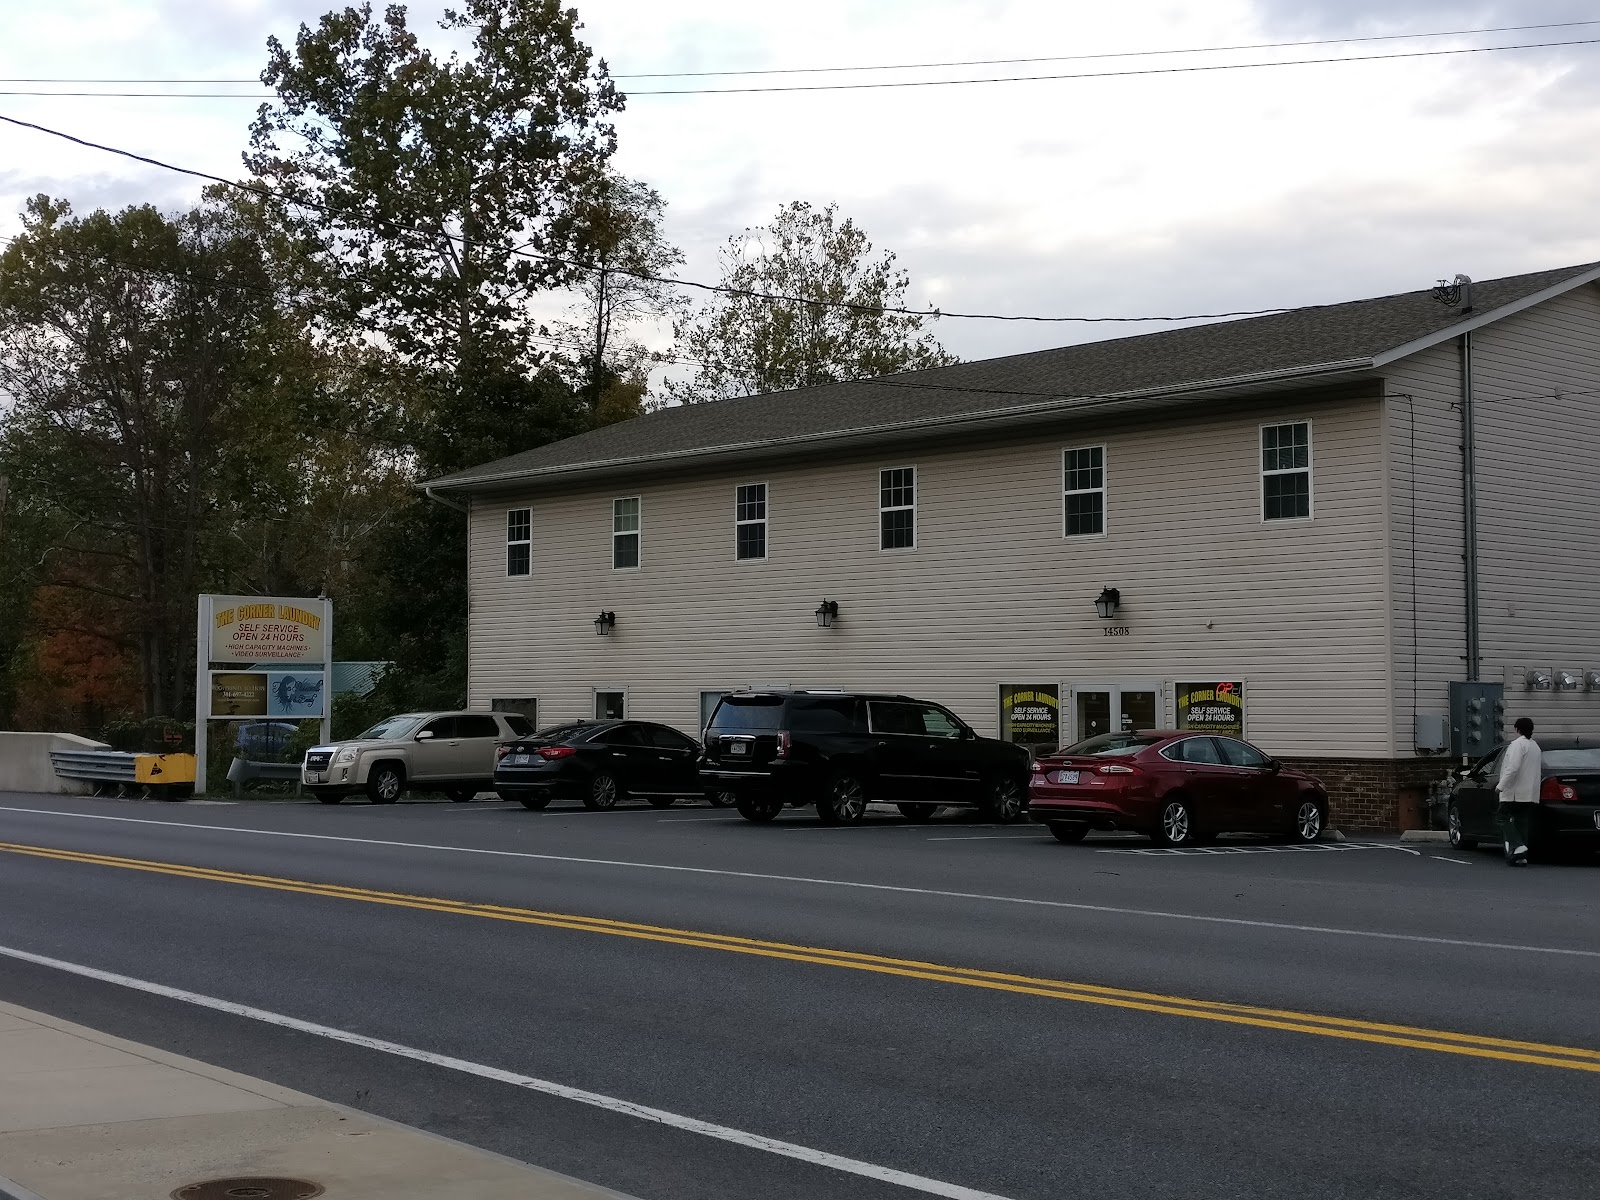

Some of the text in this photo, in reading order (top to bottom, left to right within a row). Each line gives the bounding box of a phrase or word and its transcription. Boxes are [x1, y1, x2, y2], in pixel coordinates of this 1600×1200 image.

[216, 604, 320, 631] THE CORNER LAUNDRY
[239, 624, 299, 633] SELF SERVICE
[1103, 626, 1130, 637] 14508
[232, 632, 305, 642] OPEN 24 HOURS
[1003, 695, 1013, 709] THE
[1014, 691, 1035, 704] CORNER
[1178, 694, 1189, 709] THE
[1190, 690, 1214, 704] CORNER
[1213, 714, 1235, 722] HOURS
